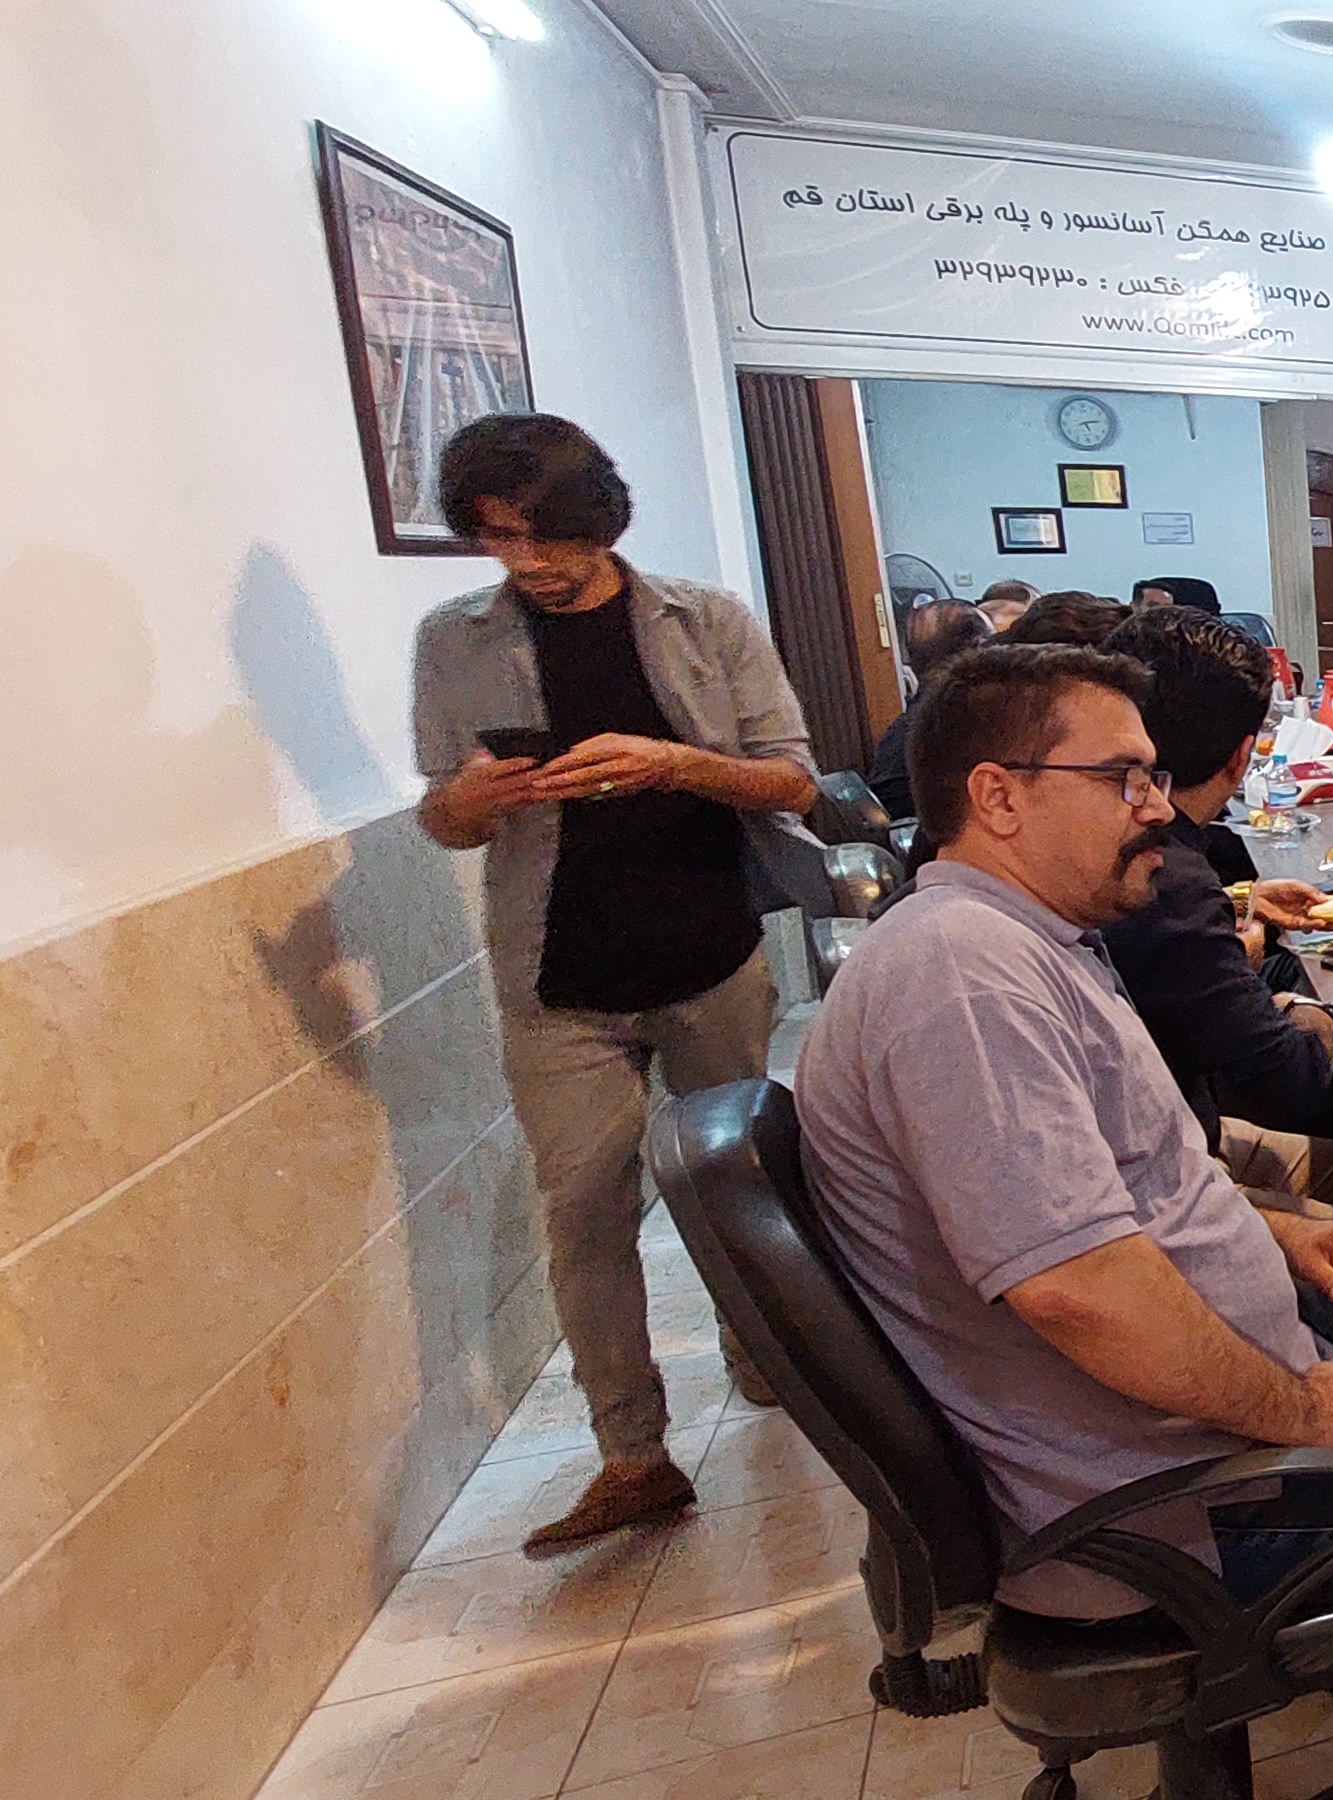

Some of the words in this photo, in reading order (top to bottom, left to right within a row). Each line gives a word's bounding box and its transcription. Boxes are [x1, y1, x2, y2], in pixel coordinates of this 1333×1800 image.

[782, 185, 823, 209] قم
[835, 189, 915, 213] استان
[925, 198, 984, 225] برقی
[993, 201, 1030, 232] پله
[1040, 213, 1053, 230] و
[1063, 209, 1165, 236] آسانسور
[1259, 229, 1326, 253] صنایع
[934, 258, 1088, 288] ۳۲۹۳۹۲۳۰
[1117, 275, 1185, 297] فکس
